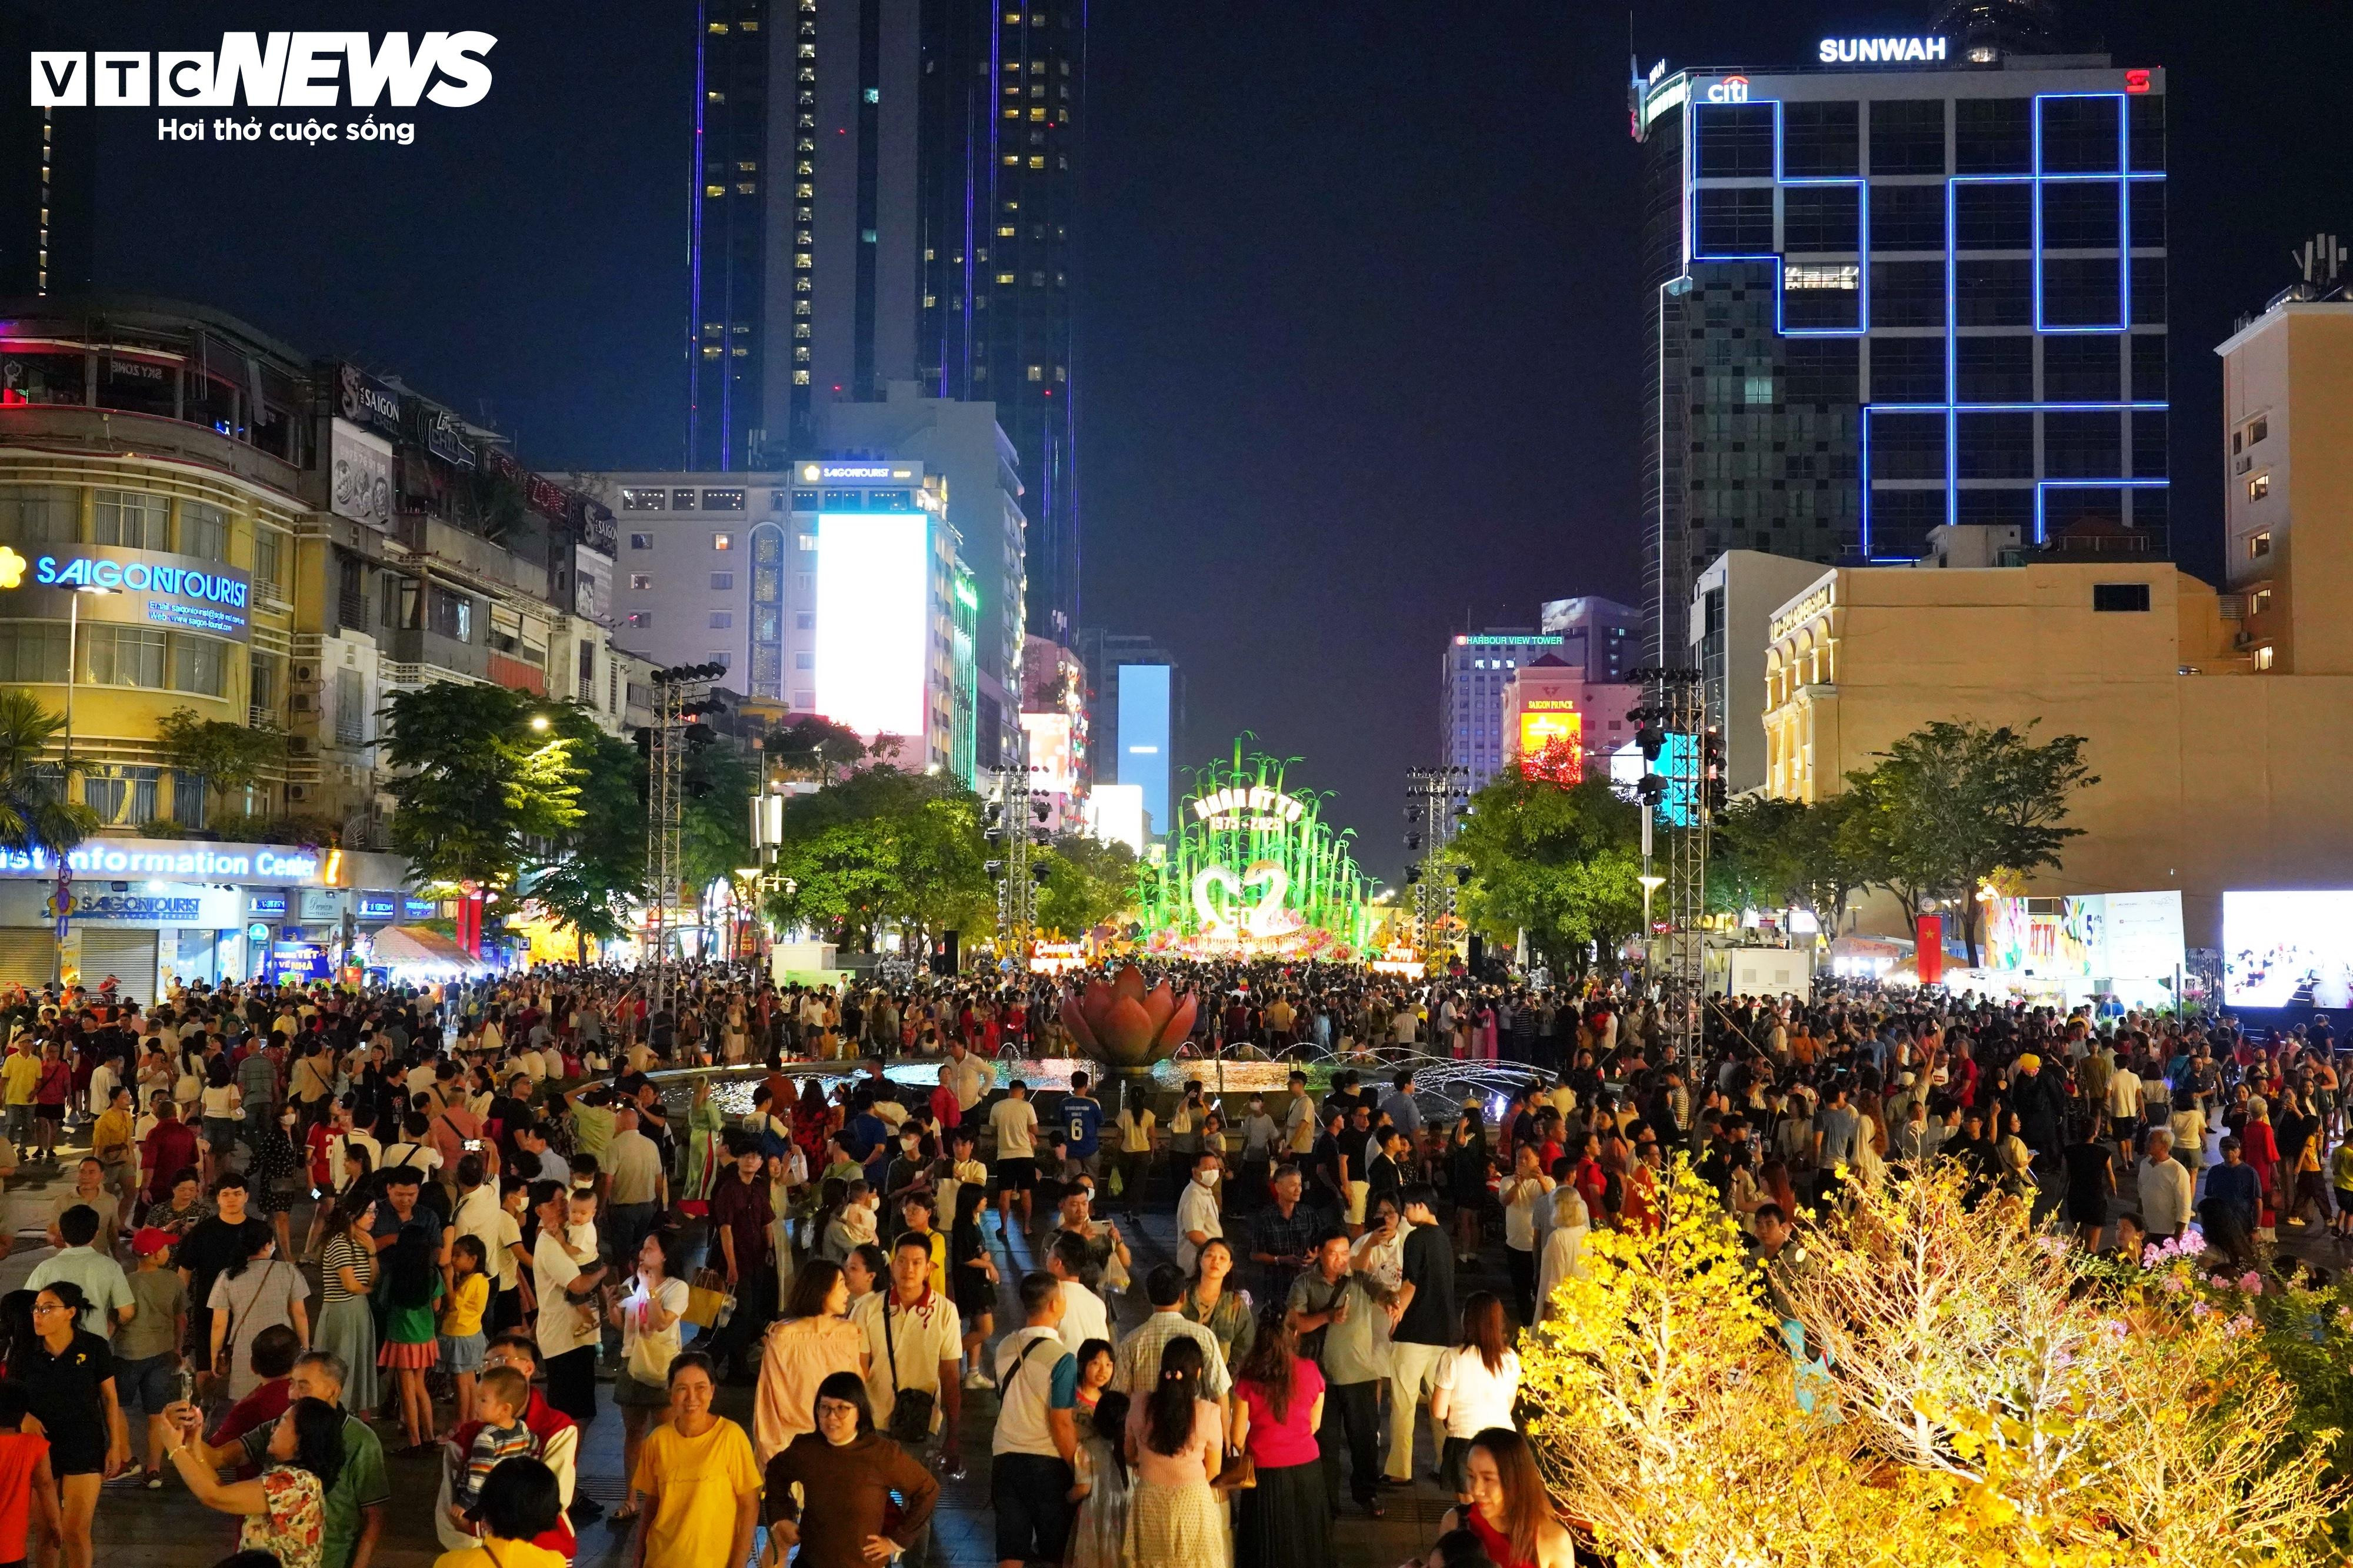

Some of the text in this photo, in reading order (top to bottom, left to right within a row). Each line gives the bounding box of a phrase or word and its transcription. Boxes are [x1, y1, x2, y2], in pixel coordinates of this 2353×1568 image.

[1819, 37, 1945, 62] SUNWAH
[1708, 79, 1748, 102] citi
[365, 388, 399, 422] SAIGON
[824, 468, 889, 477] SAIGONTOURIST
[598, 520, 618, 540] SAIGON
[37, 556, 247, 608] SAIGONTOURIST
[1467, 636, 1562, 645] HARBOUR VIEW TOWER
[1528, 700, 1574, 709] SAIGON PRINCE
[1194, 788, 1246, 820] XUÂN
[1209, 817, 1244, 830] 1975
[1257, 817, 1287, 830] 2025
[56, 847, 248, 875] nformation
[257, 852, 316, 876] Center
[81, 896, 201, 912] SAIGONTOURIST
[296, 948, 319, 959] TẾT
[291, 960, 314, 970] NHÀ
[1071, 1118, 1083, 1141] 6
